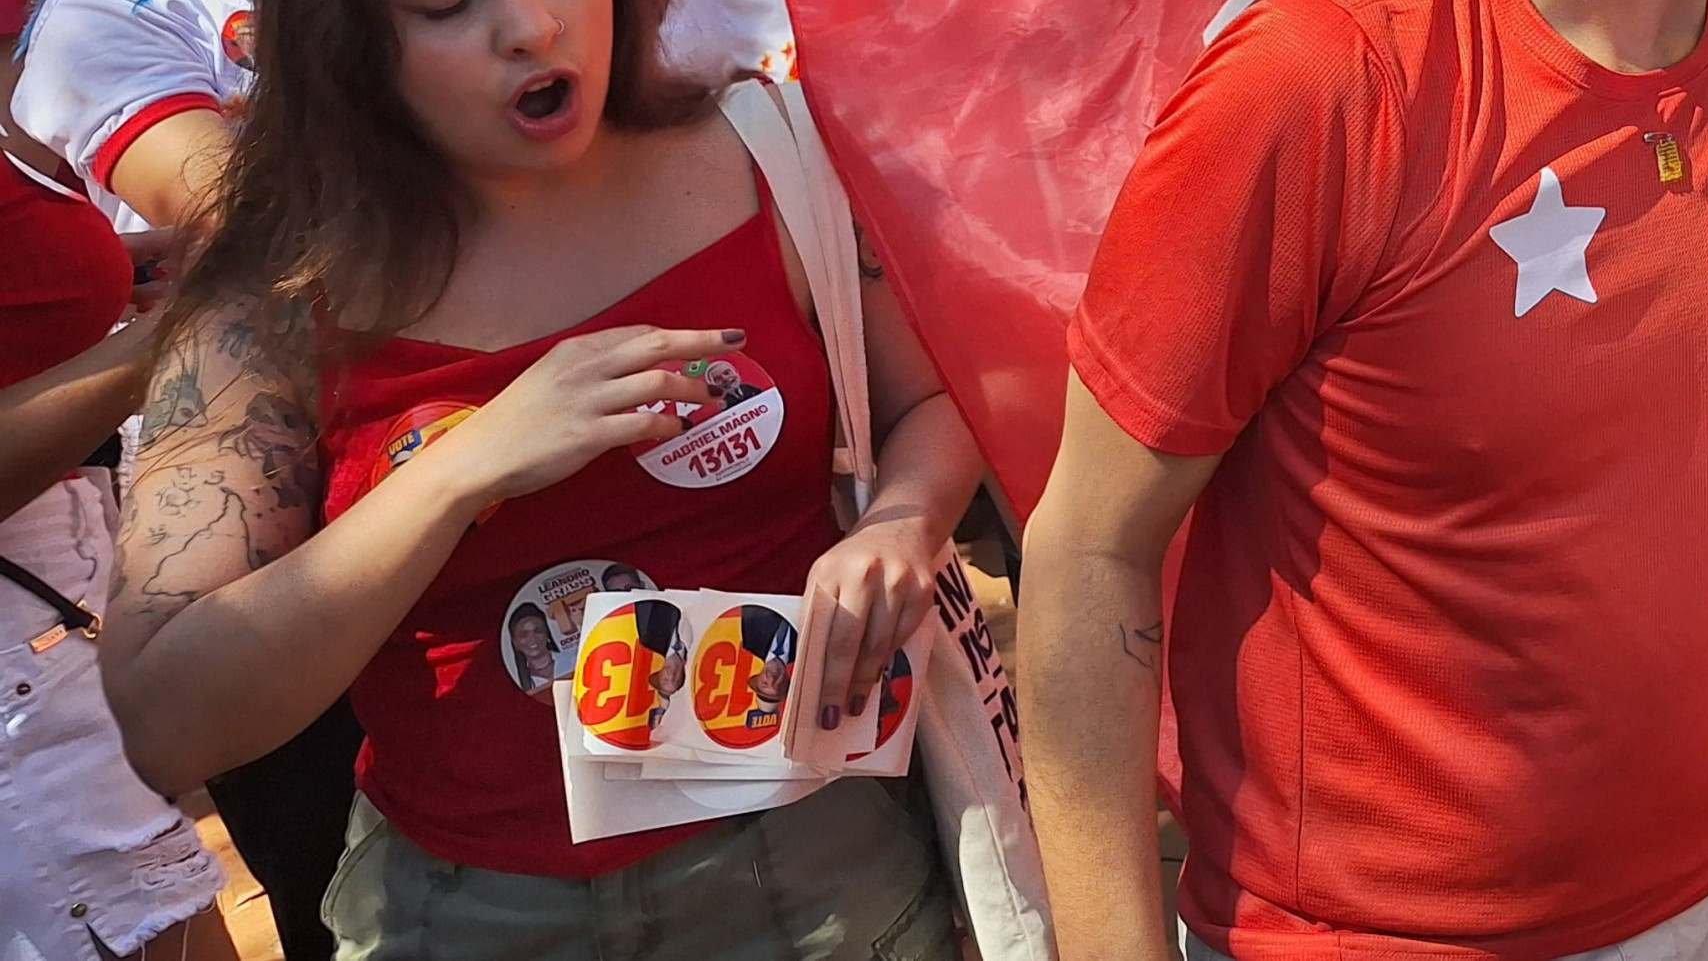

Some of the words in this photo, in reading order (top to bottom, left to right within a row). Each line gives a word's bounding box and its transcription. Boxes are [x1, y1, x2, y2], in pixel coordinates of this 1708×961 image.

[388, 431, 416, 456] VOTE
[661, 430, 720, 466] GABRIEL
[721, 404, 769, 436] MAGNO
[687, 426, 763, 480] 13131
[576, 639, 656, 726] 13
[694, 640, 754, 722] 13
[751, 714, 778, 728] VOTE
